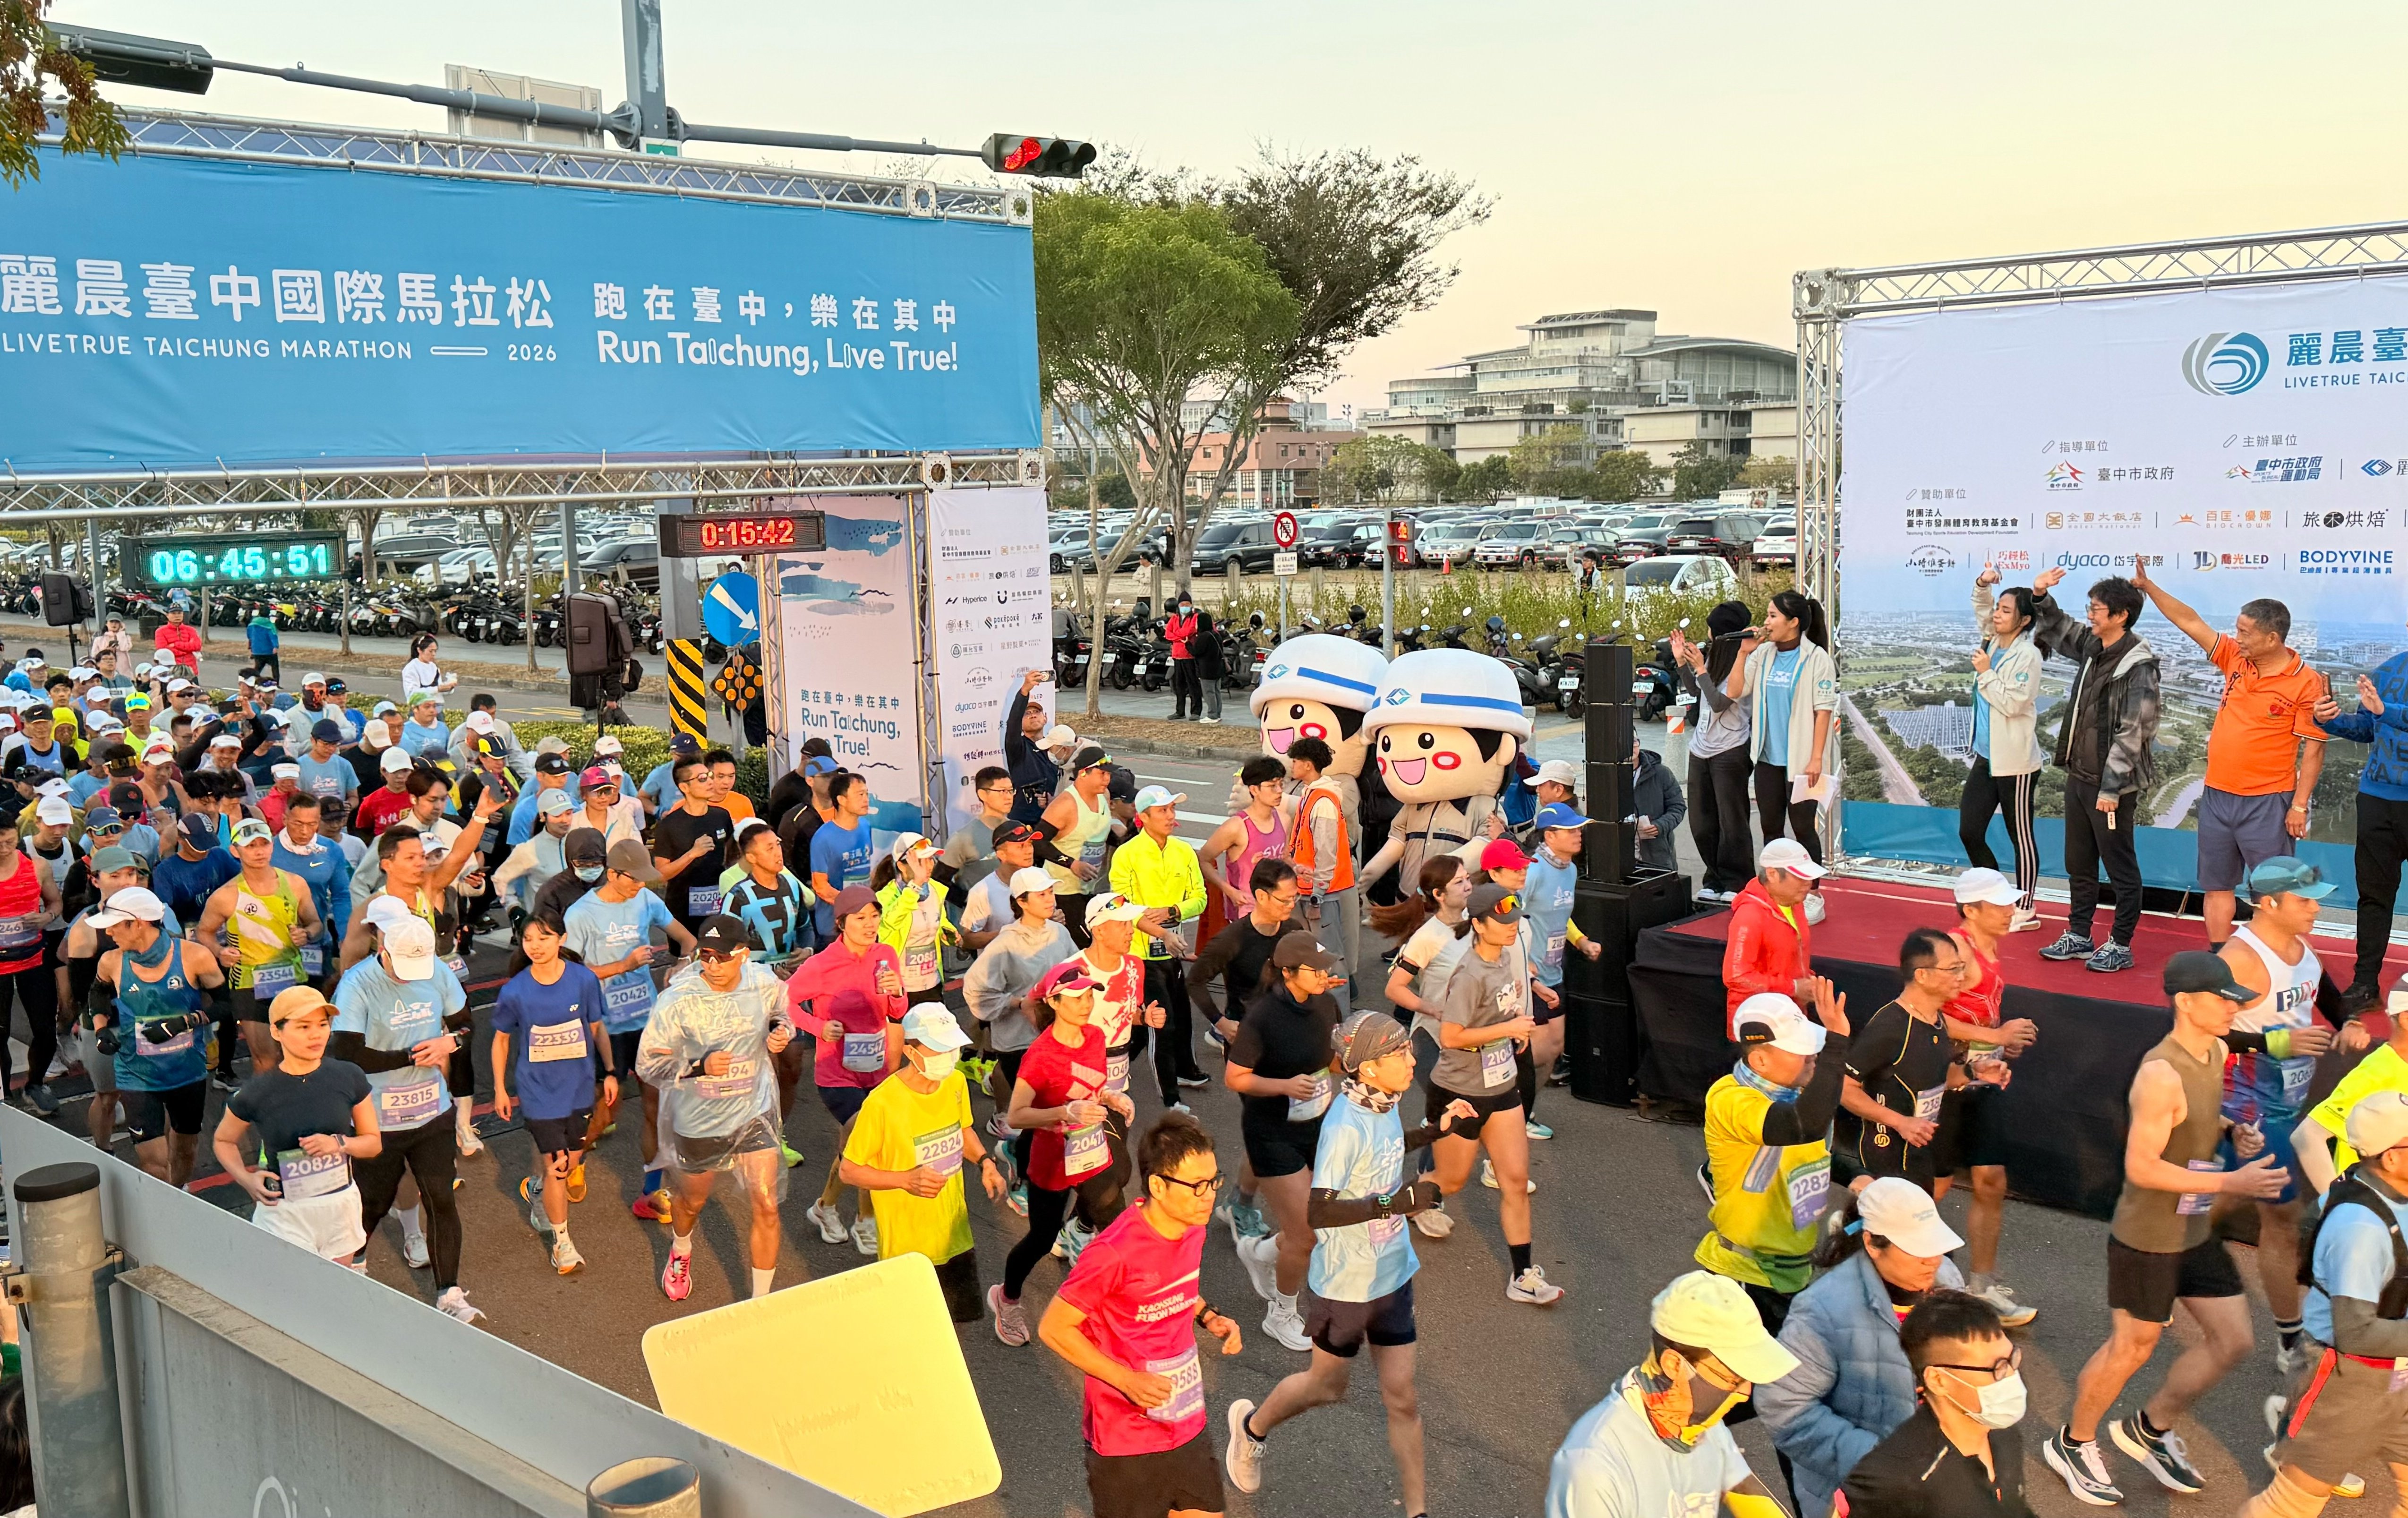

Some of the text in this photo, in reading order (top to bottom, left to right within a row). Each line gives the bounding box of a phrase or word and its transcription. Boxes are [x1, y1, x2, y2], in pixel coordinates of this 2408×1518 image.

[0, 254, 555, 329] 麗晨臺中國際馬拉松
[2, 332, 558, 362] LIVETRUE TAICHUNG MARATHON 2026
[597, 330, 661, 365] Run
[667, 332, 820, 377] Taichung,
[890, 340, 959, 372] True!
[2284, 371, 2408, 389] LIVETRUE TAIC
[2058, 440, 2109, 453] 指導單位
[2242, 434, 2297, 447] 主辦單位
[2255, 455, 2323, 472] 臺中市政府
[2097, 465, 2175, 481] 臺中市政府
[2280, 467, 2322, 482] 運動局
[1921, 488, 1967, 500] 贊助單位
[1906, 508, 1942, 518] 財團法人
[2066, 512, 2142, 522] 全國大飯店
[2302, 510, 2385, 528] 旅禾烘焙
[701, 518, 794, 547] 0:15:42
[152, 544, 328, 583] 06:45:51
[2057, 550, 2110, 571] dyaco
[2300, 550, 2393, 563] BODYVINE
[955, 703, 977, 713] dyaco
[802, 707, 828, 728] Run
[830, 710, 901, 740] Taichung,
[952, 721, 987, 732] BODYVINE
[833, 734, 870, 756] True!
[534, 1029, 580, 1046] 22339
[390, 1088, 433, 1106] 23815
[922, 1133, 961, 1161] 22824
[286, 1154, 342, 1178] 20823
[1135, 1308, 1169, 1322] FUBON
